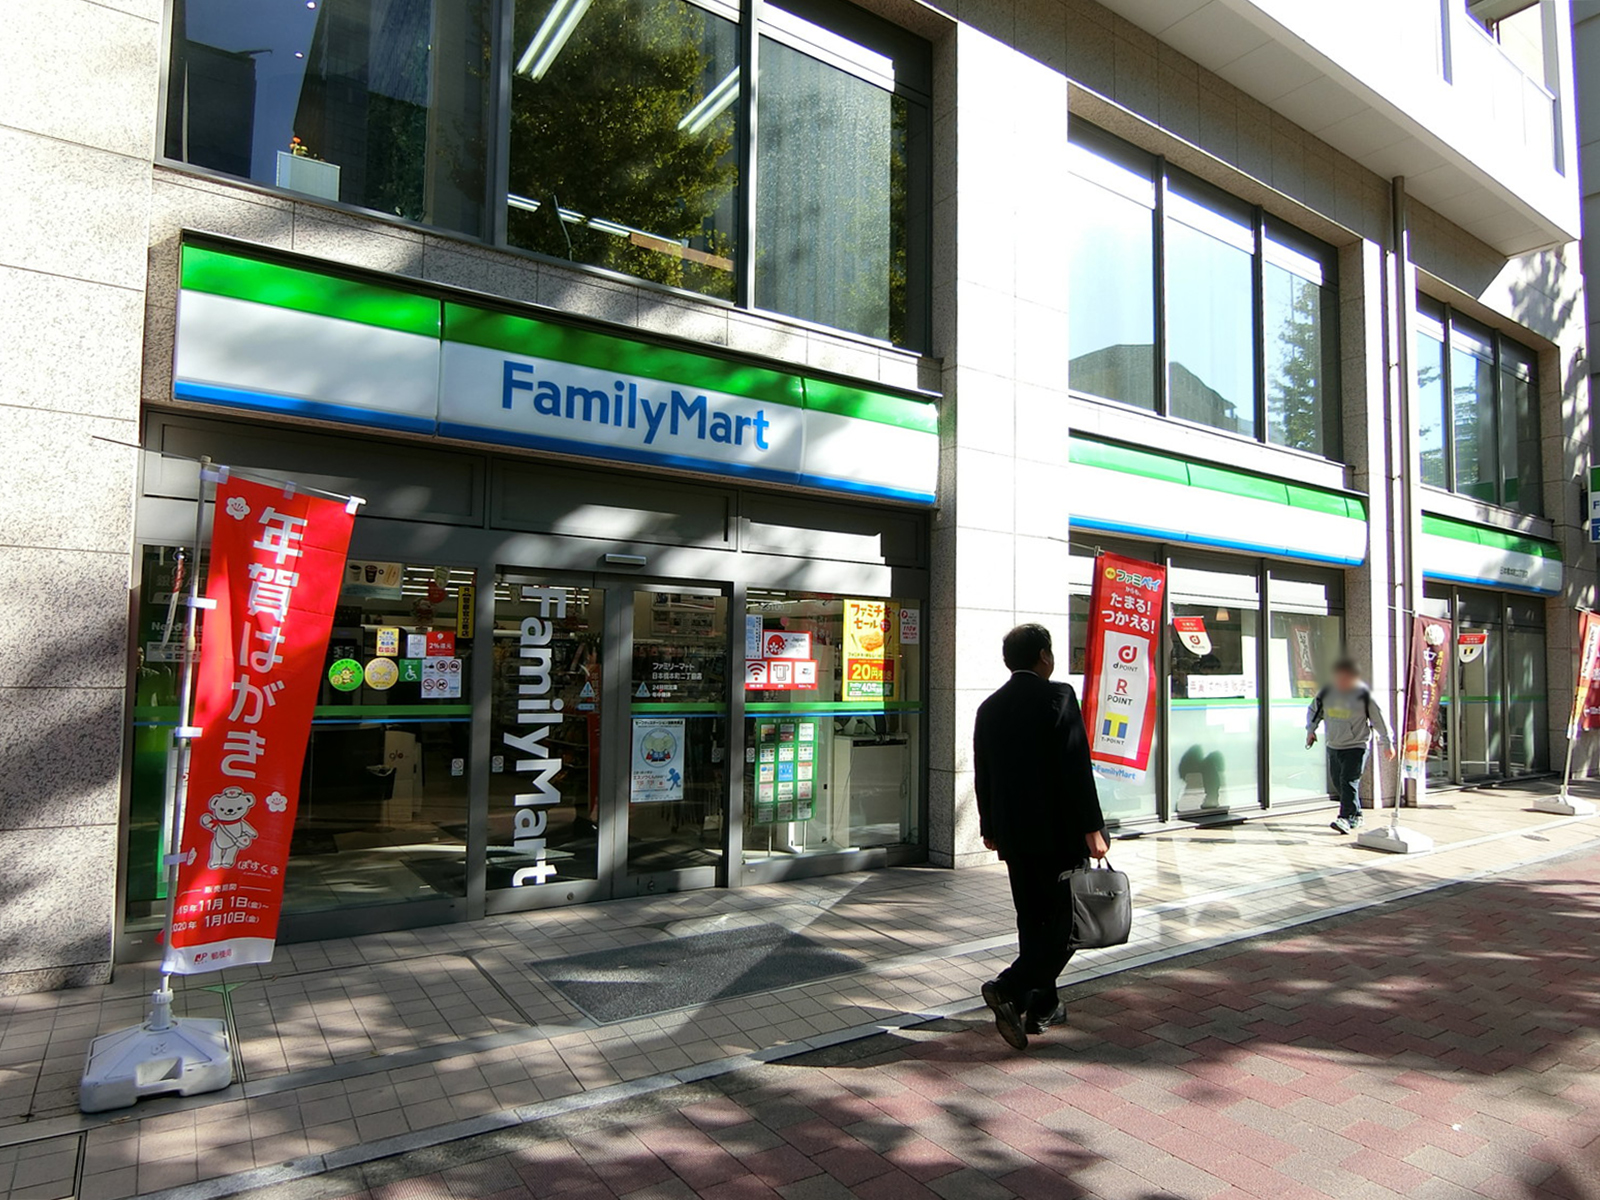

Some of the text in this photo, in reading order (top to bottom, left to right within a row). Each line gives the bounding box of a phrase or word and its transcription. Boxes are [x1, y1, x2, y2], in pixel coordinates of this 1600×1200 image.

[501, 360, 770, 450] FamilyMart
[1116, 569, 1161, 592] ファミペイ
[850, 603, 893, 618] ファミチキ
[1109, 592, 1152, 616] たまる!
[853, 617, 878, 630] セール
[1101, 610, 1155, 634] つかえる!
[220, 506, 308, 779] 年賀はがき
[652, 662, 695, 671] ファミリーマート
[1119, 664, 1139, 673] POINT
[1115, 678, 1129, 694] R
[1107, 694, 1133, 706] POINT
[503, 585, 567, 887] FamilyMart
[1101, 737, 1125, 746] T-POINT
[388, 749, 404, 762] glo
[1096, 764, 1136, 780] FamilyMart
[237, 859, 280, 876] ぽすくま
